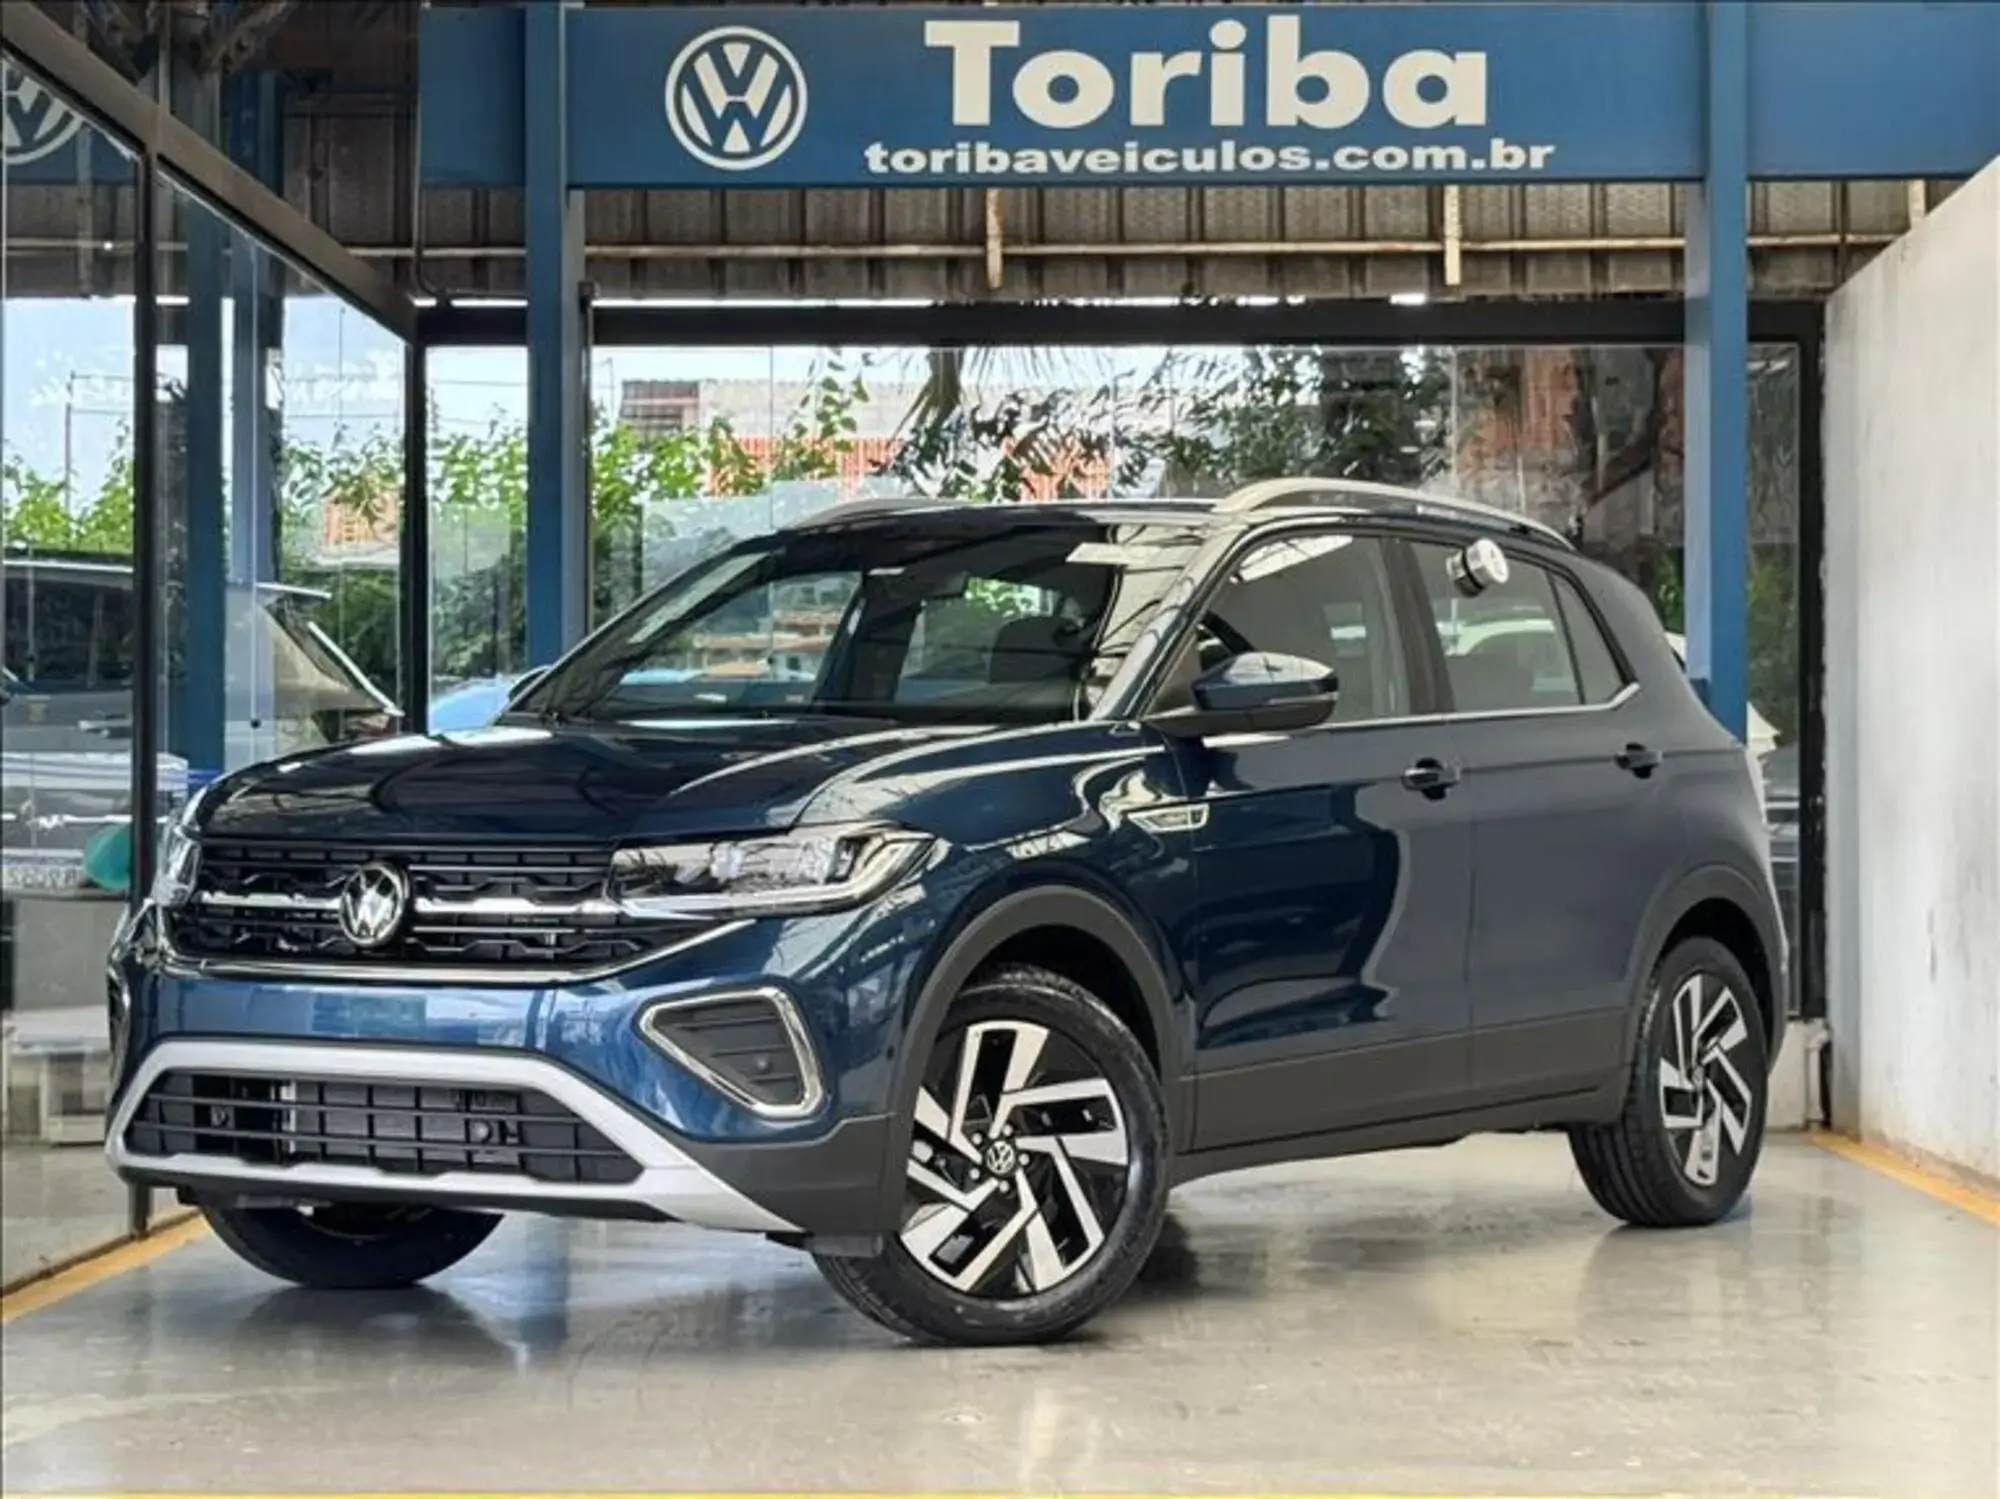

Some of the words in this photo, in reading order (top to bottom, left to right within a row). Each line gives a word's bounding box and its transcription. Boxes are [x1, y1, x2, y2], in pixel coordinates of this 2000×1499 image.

[674, 35, 798, 160] VW
[924, 15, 1486, 128] Toriba
[864, 138, 1555, 173] toribaveiculos.com.br
